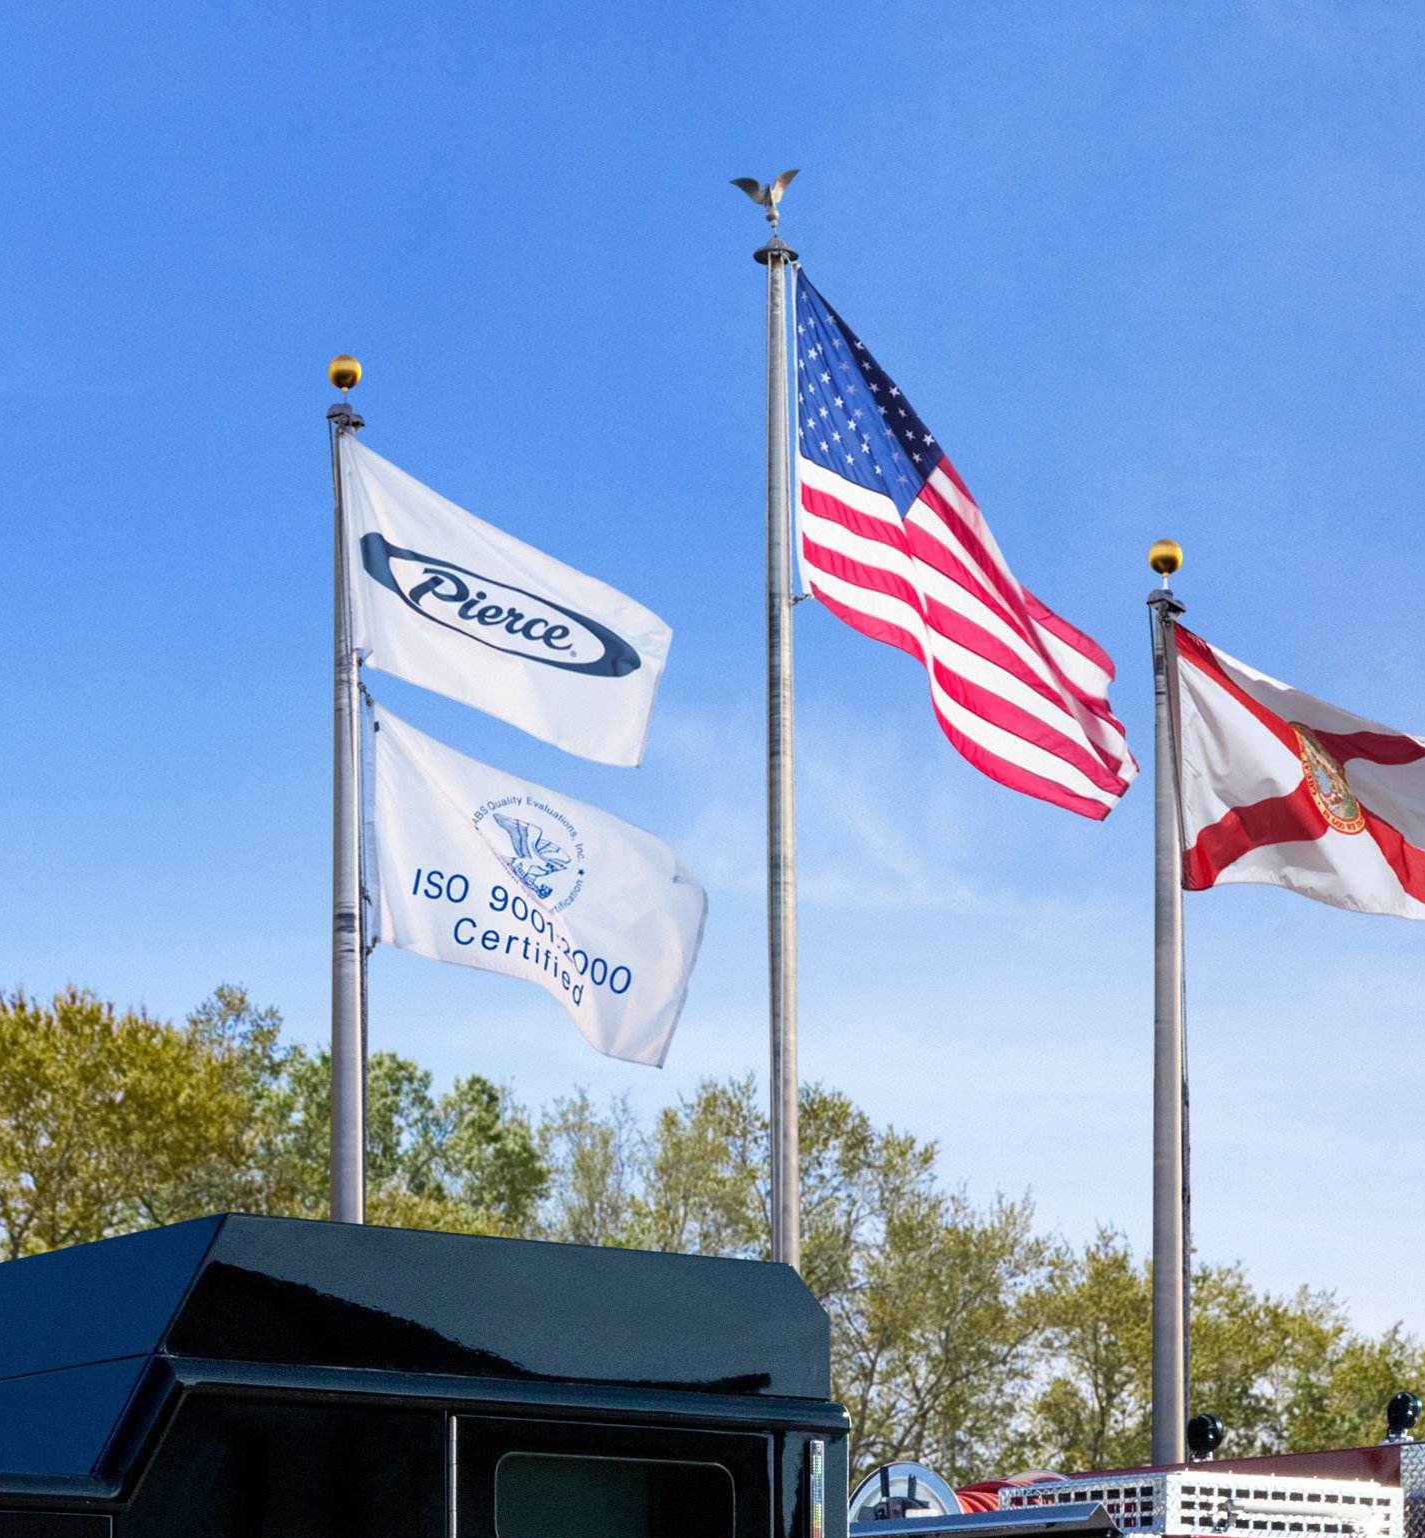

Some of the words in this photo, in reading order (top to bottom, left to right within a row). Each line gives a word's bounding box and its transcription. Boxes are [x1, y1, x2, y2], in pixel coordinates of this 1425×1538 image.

[408, 567, 573, 651] Pierce
[472, 805, 489, 825] ABS
[486, 796, 523, 812] Quality
[411, 867, 470, 904] ISO
[488, 884, 633, 995] 9001:2000
[549, 878, 584, 915] rtification
[453, 917, 585, 1007] Certified
